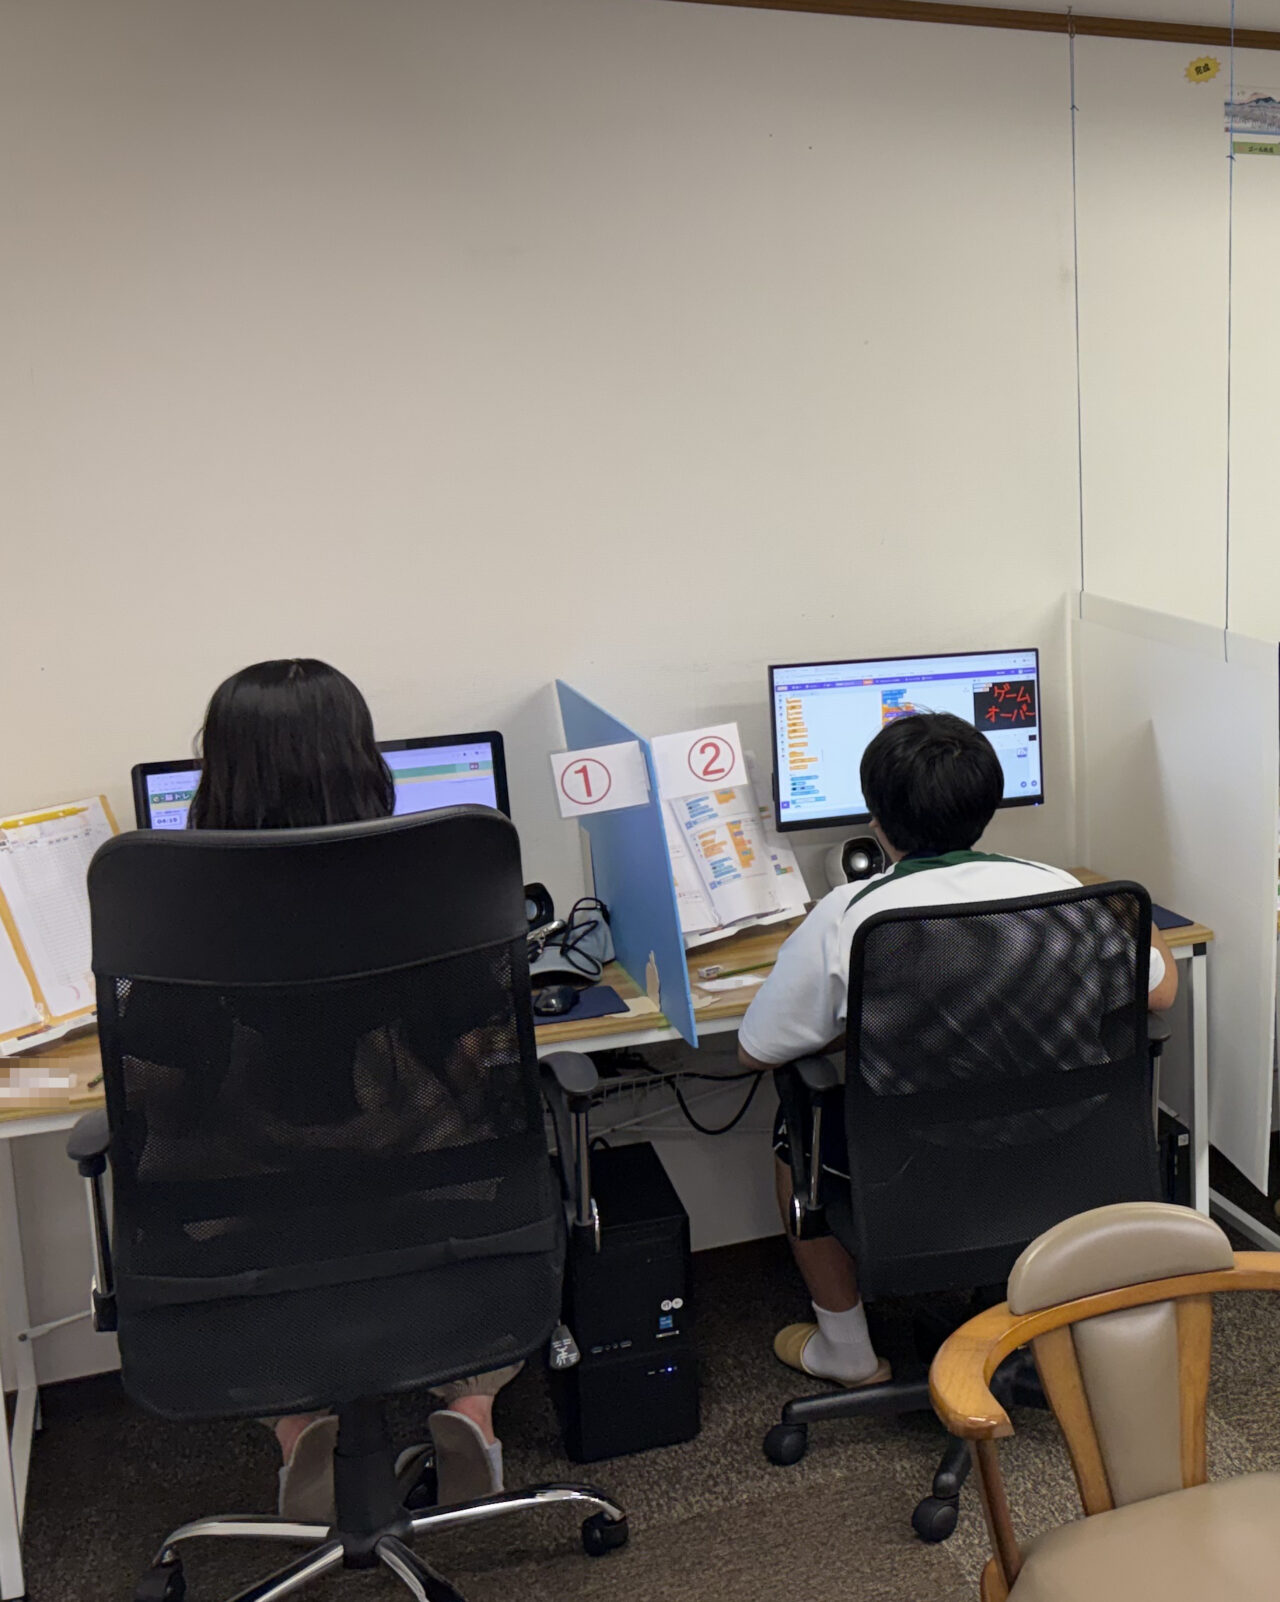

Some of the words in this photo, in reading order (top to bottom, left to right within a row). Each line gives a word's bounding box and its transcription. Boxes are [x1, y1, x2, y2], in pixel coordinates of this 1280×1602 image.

[994, 682, 1031, 703] ゲーム
[985, 704, 1036, 723] オーバー
